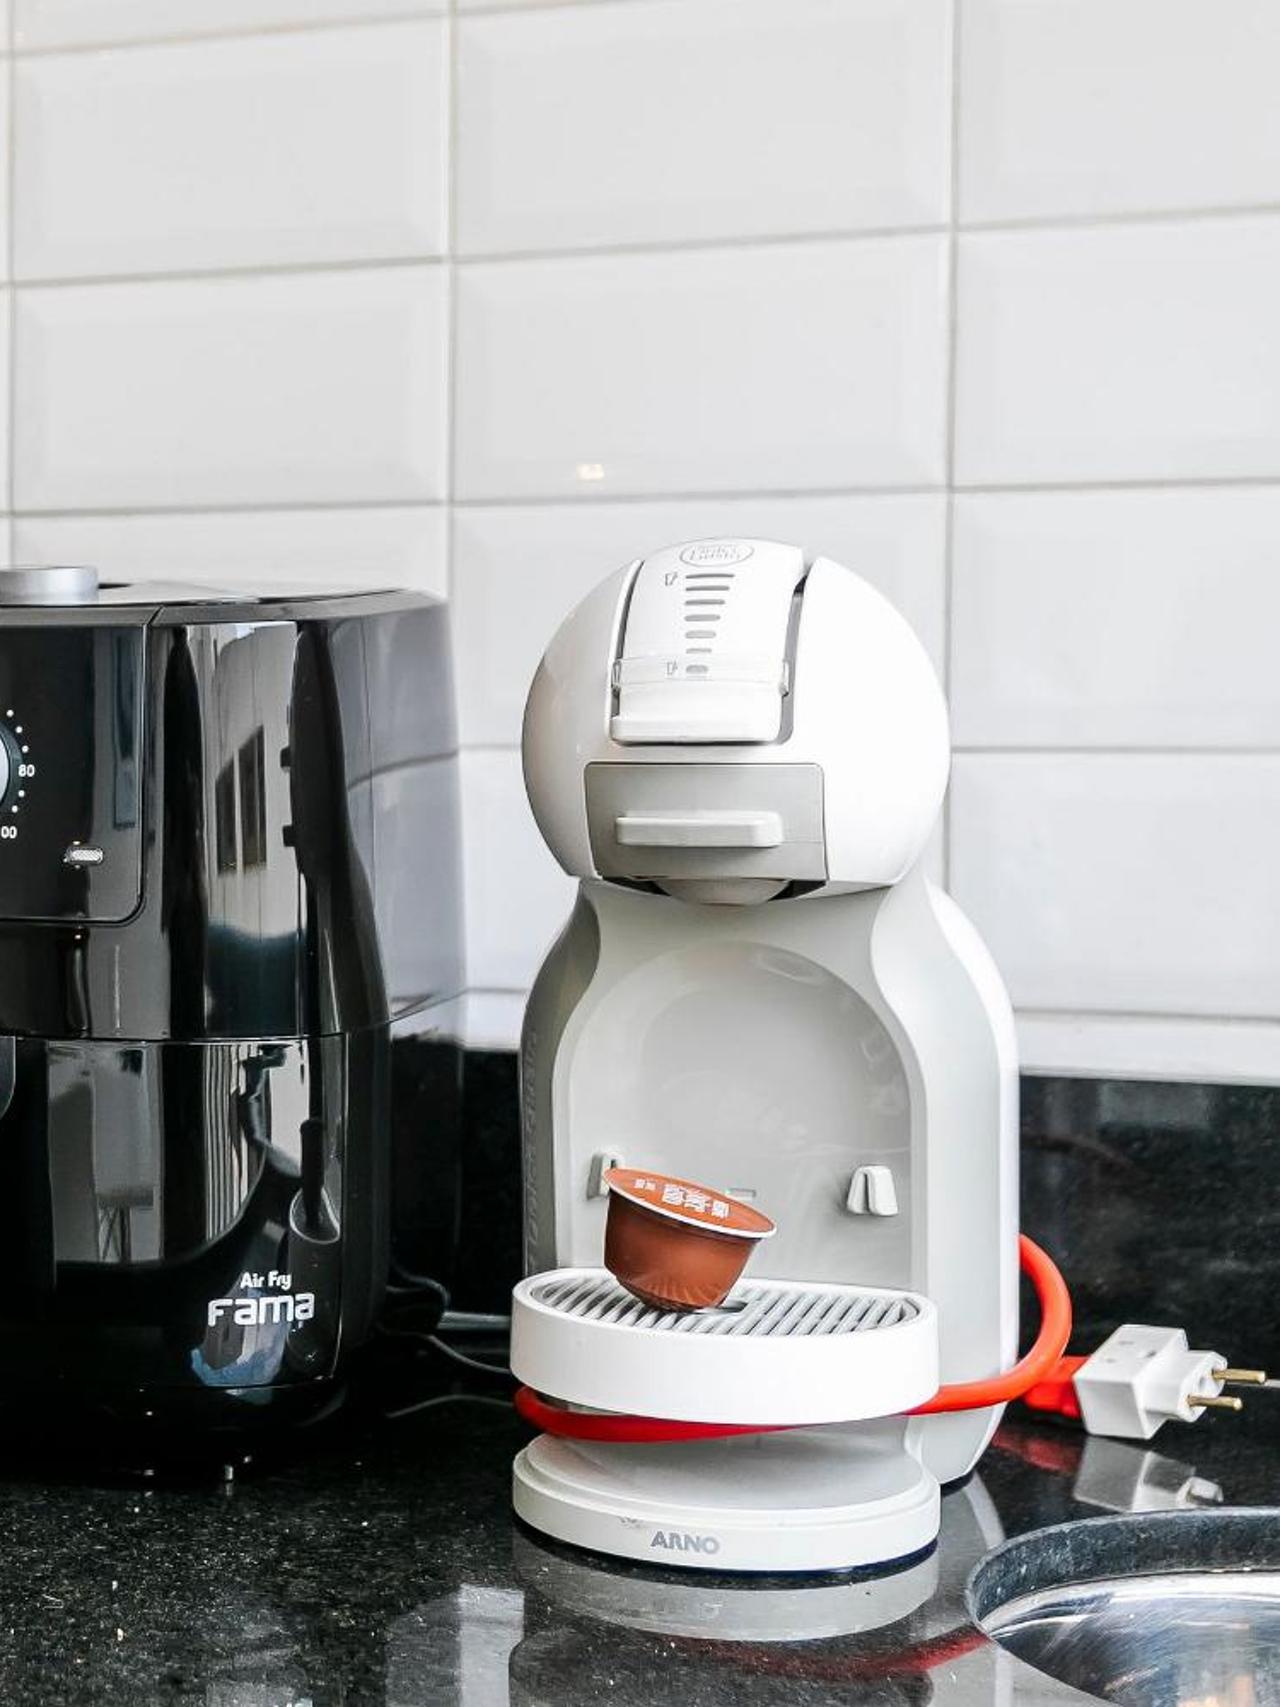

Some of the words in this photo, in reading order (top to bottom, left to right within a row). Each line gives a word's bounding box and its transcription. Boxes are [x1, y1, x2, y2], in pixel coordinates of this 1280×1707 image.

[18, 764, 35, 777] 80
[240, 1271, 265, 1288] Air
[267, 1270, 292, 1290] Fry
[650, 1530, 719, 1554] ARNO
